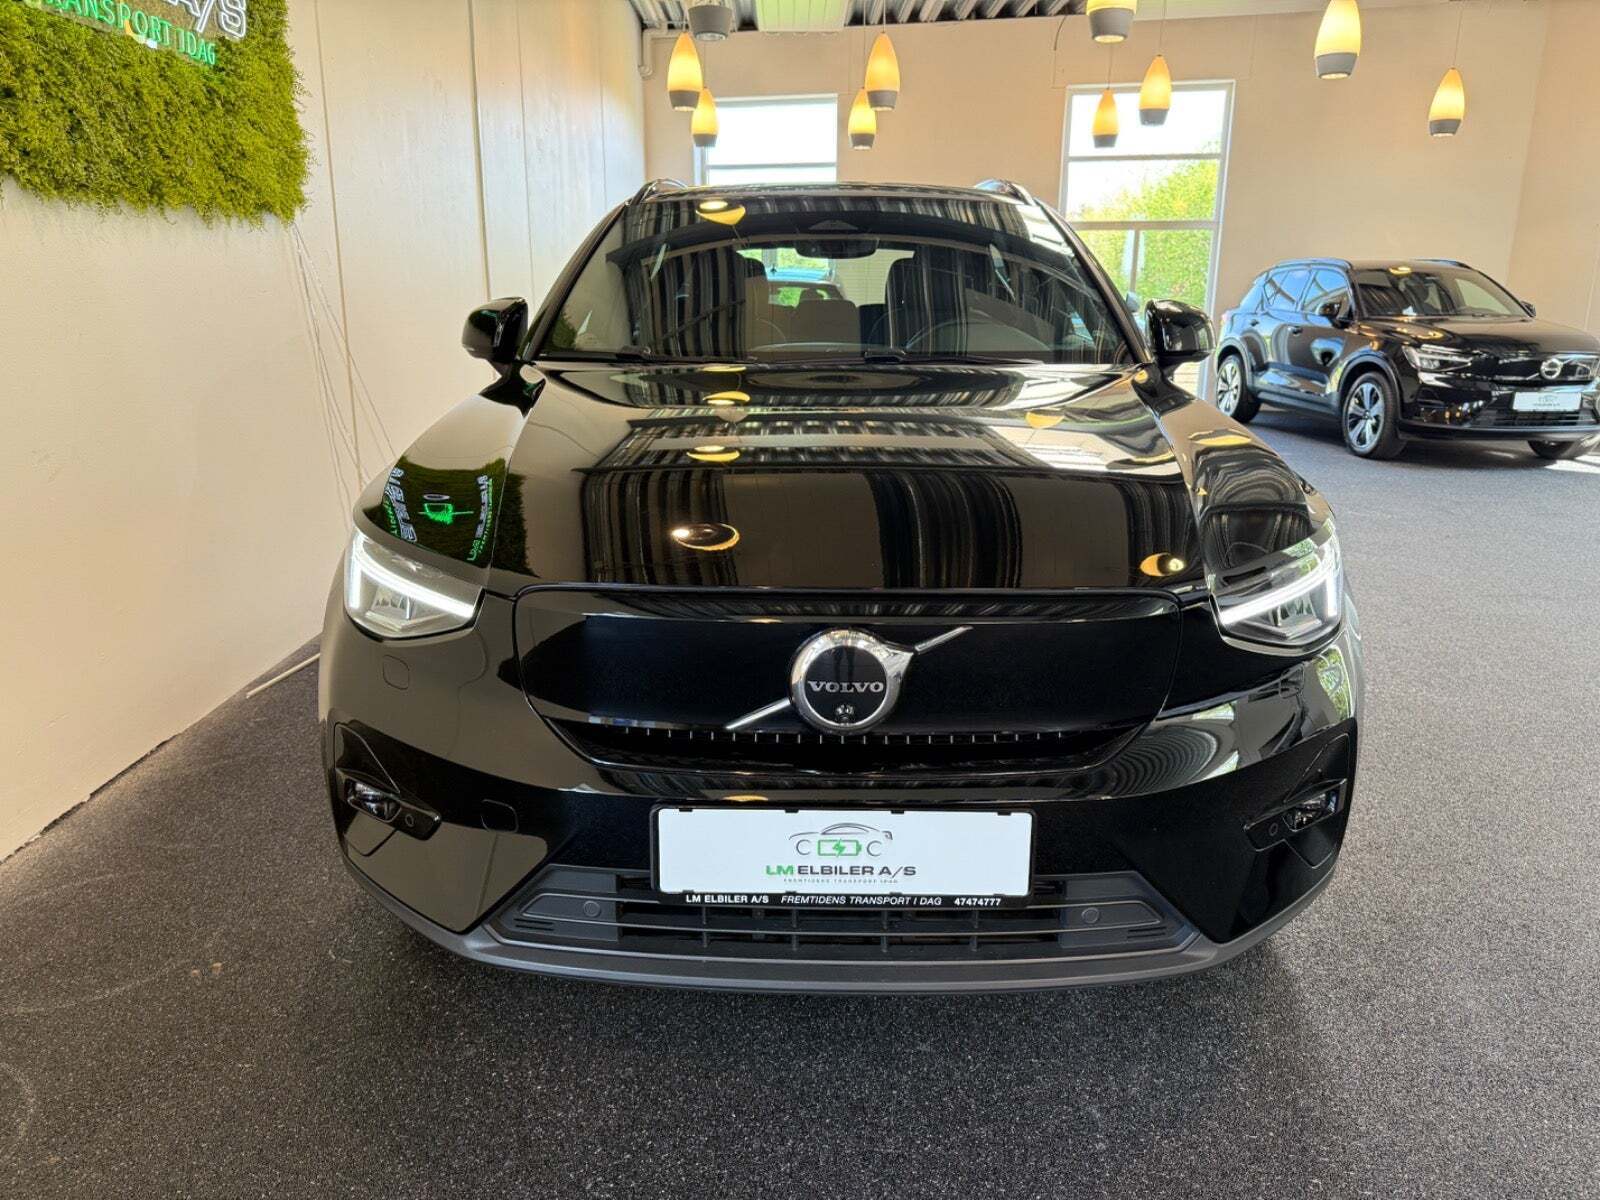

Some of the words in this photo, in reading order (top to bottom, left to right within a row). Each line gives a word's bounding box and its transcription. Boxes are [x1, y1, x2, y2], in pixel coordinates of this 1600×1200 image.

[167, 0, 246, 38] /S
[807, 680, 885, 693] VOLVO
[765, 865, 794, 876] LM
[797, 865, 875, 876] ELBILER
[878, 866, 917, 879] A/S
[685, 894, 702, 904] LM
[704, 894, 748, 904] ELBILER
[750, 895, 769, 904] A/S
[780, 895, 846, 905] FREMTIDENS
[849, 896, 912, 905] TRANSPORT
[919, 896, 942, 906] DAG
[954, 897, 1002, 907] 47474777
